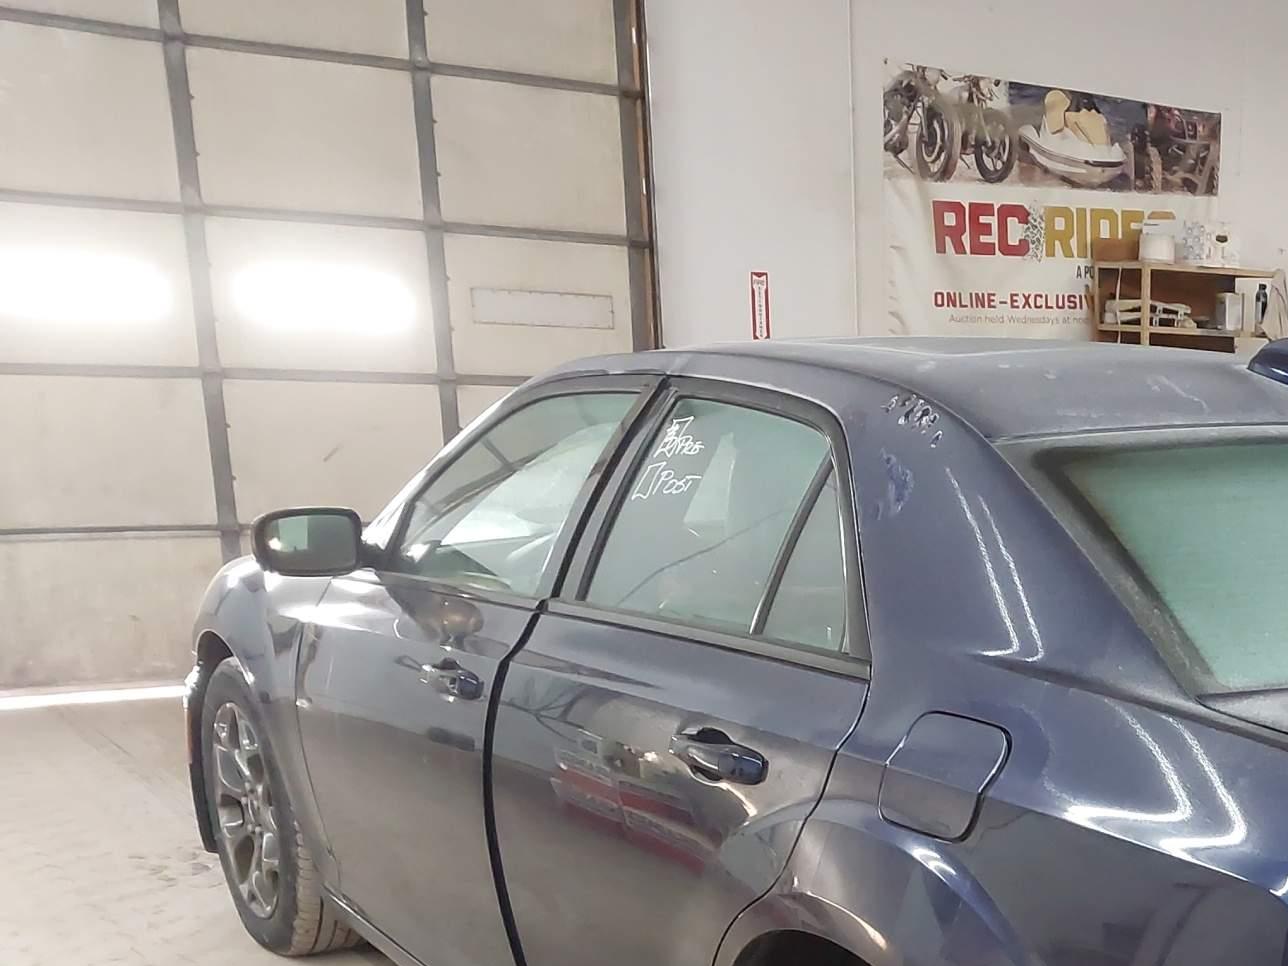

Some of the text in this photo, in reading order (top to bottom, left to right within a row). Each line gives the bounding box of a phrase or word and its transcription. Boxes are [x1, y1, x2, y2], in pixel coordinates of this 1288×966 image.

[933, 200, 1176, 259] REC RIDE
[1076, 265, 1082, 279] A
